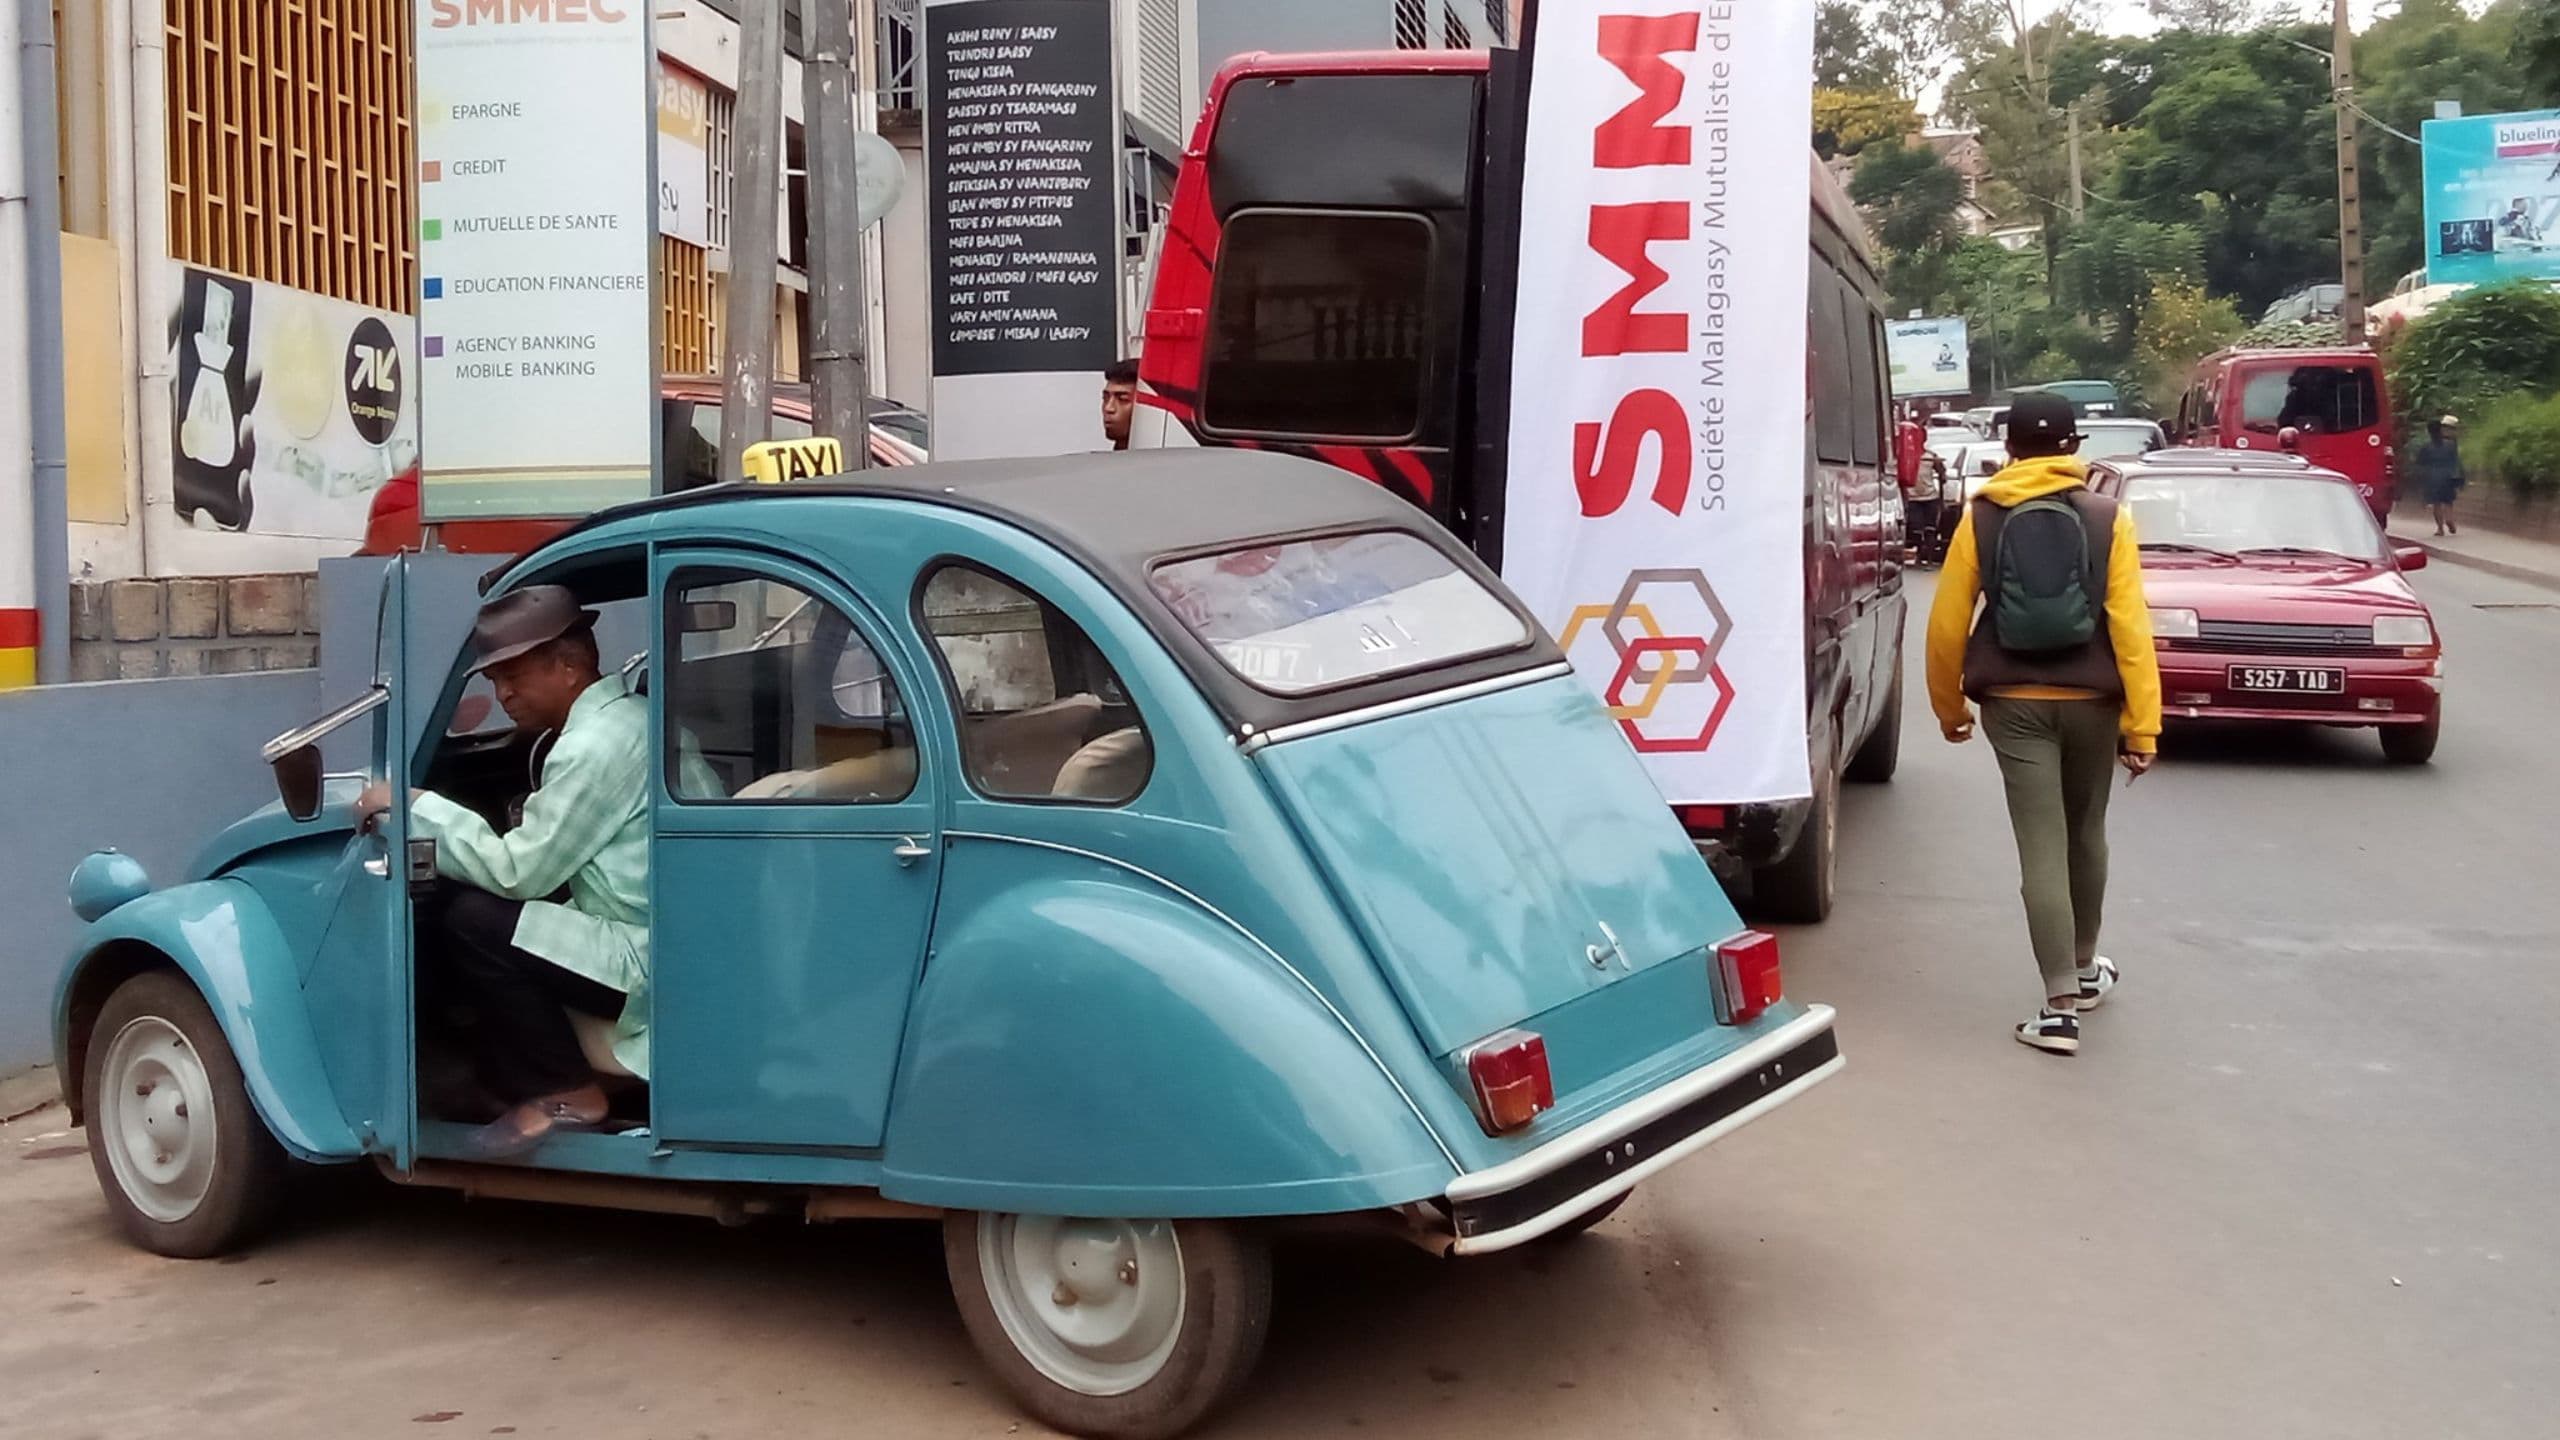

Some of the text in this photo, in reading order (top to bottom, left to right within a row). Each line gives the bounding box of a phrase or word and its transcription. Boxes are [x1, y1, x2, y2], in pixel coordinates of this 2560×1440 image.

[431, 0, 626, 28] SMMEC
[947, 30, 979, 44] AKOHO
[982, 28, 1012, 40] RONY
[947, 47, 995, 62] TRONDRO
[948, 65, 1014, 81] TONGO KISOA
[948, 83, 1097, 99] HENAKISOA SY FANGARONY
[453, 103, 520, 119] EPARGNE
[989, 103, 1004, 115] SY
[1006, 102, 1076, 114] TSARAMASO
[1005, 121, 1041, 133] RITRA
[1004, 140, 1019, 152] SY
[1021, 140, 1092, 153] FANGARONY
[453, 159, 506, 175] CREDIT
[999, 159, 1013, 171] SY
[1016, 158, 1082, 171] HENAKISOA
[999, 178, 1014, 190] SY
[1012, 196, 1026, 208] SY
[454, 215, 617, 232] MUTUELLE DE SANTE
[949, 214, 1062, 230] TRIPE SY HENAKISOA
[950, 236, 974, 248] MOFO
[1701, 0, 1735, 511] Société Malagasy Mutualiste d'E
[455, 276, 645, 293] EDUCATION FINANCIERE
[950, 273, 974, 285] MOFO
[977, 271, 1026, 284] AKINDRO
[1036, 271, 1065, 283] MOFO
[1068, 271, 1098, 284] GASY
[950, 292, 975, 304] KAFE
[984, 290, 1010, 303] DITE
[951, 311, 977, 322] VARY
[456, 335, 595, 352] AGENCY BANKING
[456, 361, 595, 378] MOBILE BANKING
[768, 444, 837, 483] TAXI
[2244, 668, 2329, 690] 5257 TAD
